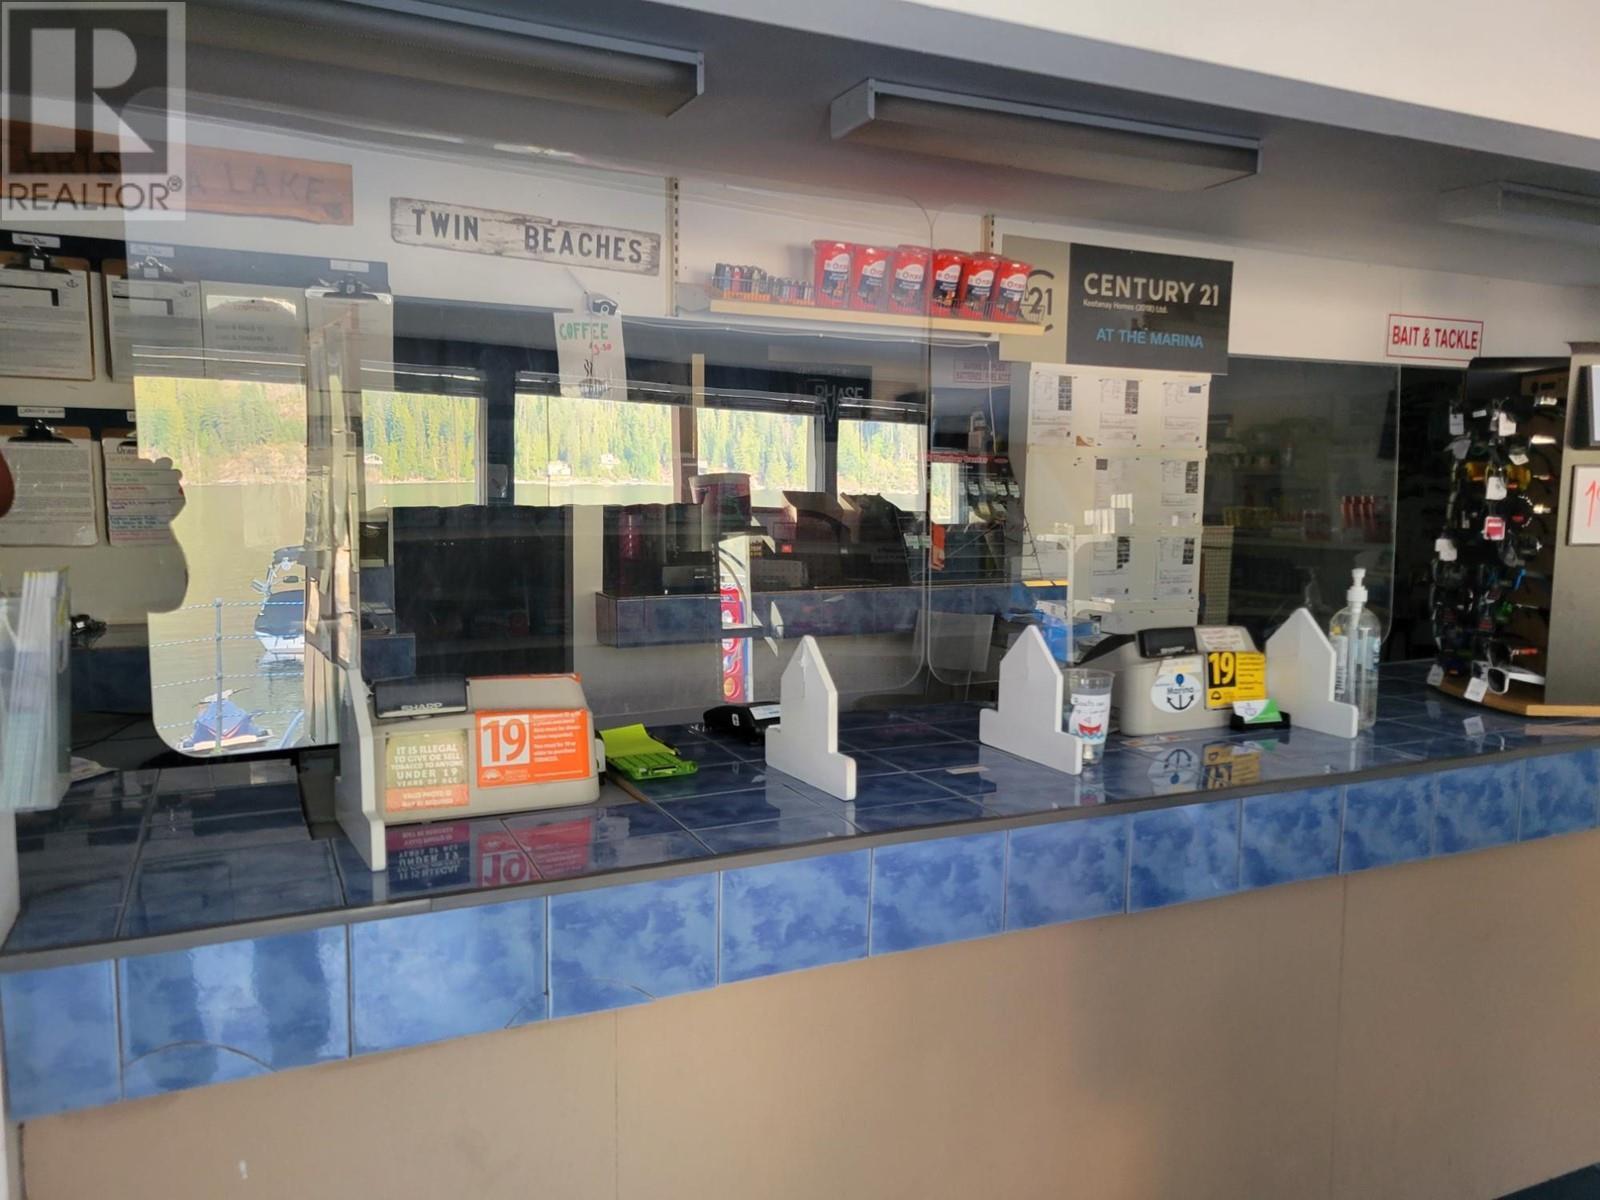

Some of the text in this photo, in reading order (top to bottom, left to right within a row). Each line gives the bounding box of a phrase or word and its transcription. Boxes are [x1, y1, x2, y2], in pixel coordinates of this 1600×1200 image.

[224, 161, 325, 203] LAKE
[411, 207, 643, 264] TWIN BEACHES
[1083, 272, 1219, 307] CENTURY 21
[559, 322, 609, 341] COFFEE
[1096, 327, 1204, 349] AT THE MARINA
[1392, 325, 1479, 350] BAIT & TACKLE
[1208, 652, 1235, 686] 19
[401, 702, 443, 712] SHARP
[396, 743, 458, 755] IT IS ILLEGAL
[482, 718, 527, 763] 19
[394, 752, 461, 763] TO GIVE OR SELL
[396, 767, 458, 780] UNDER 19
